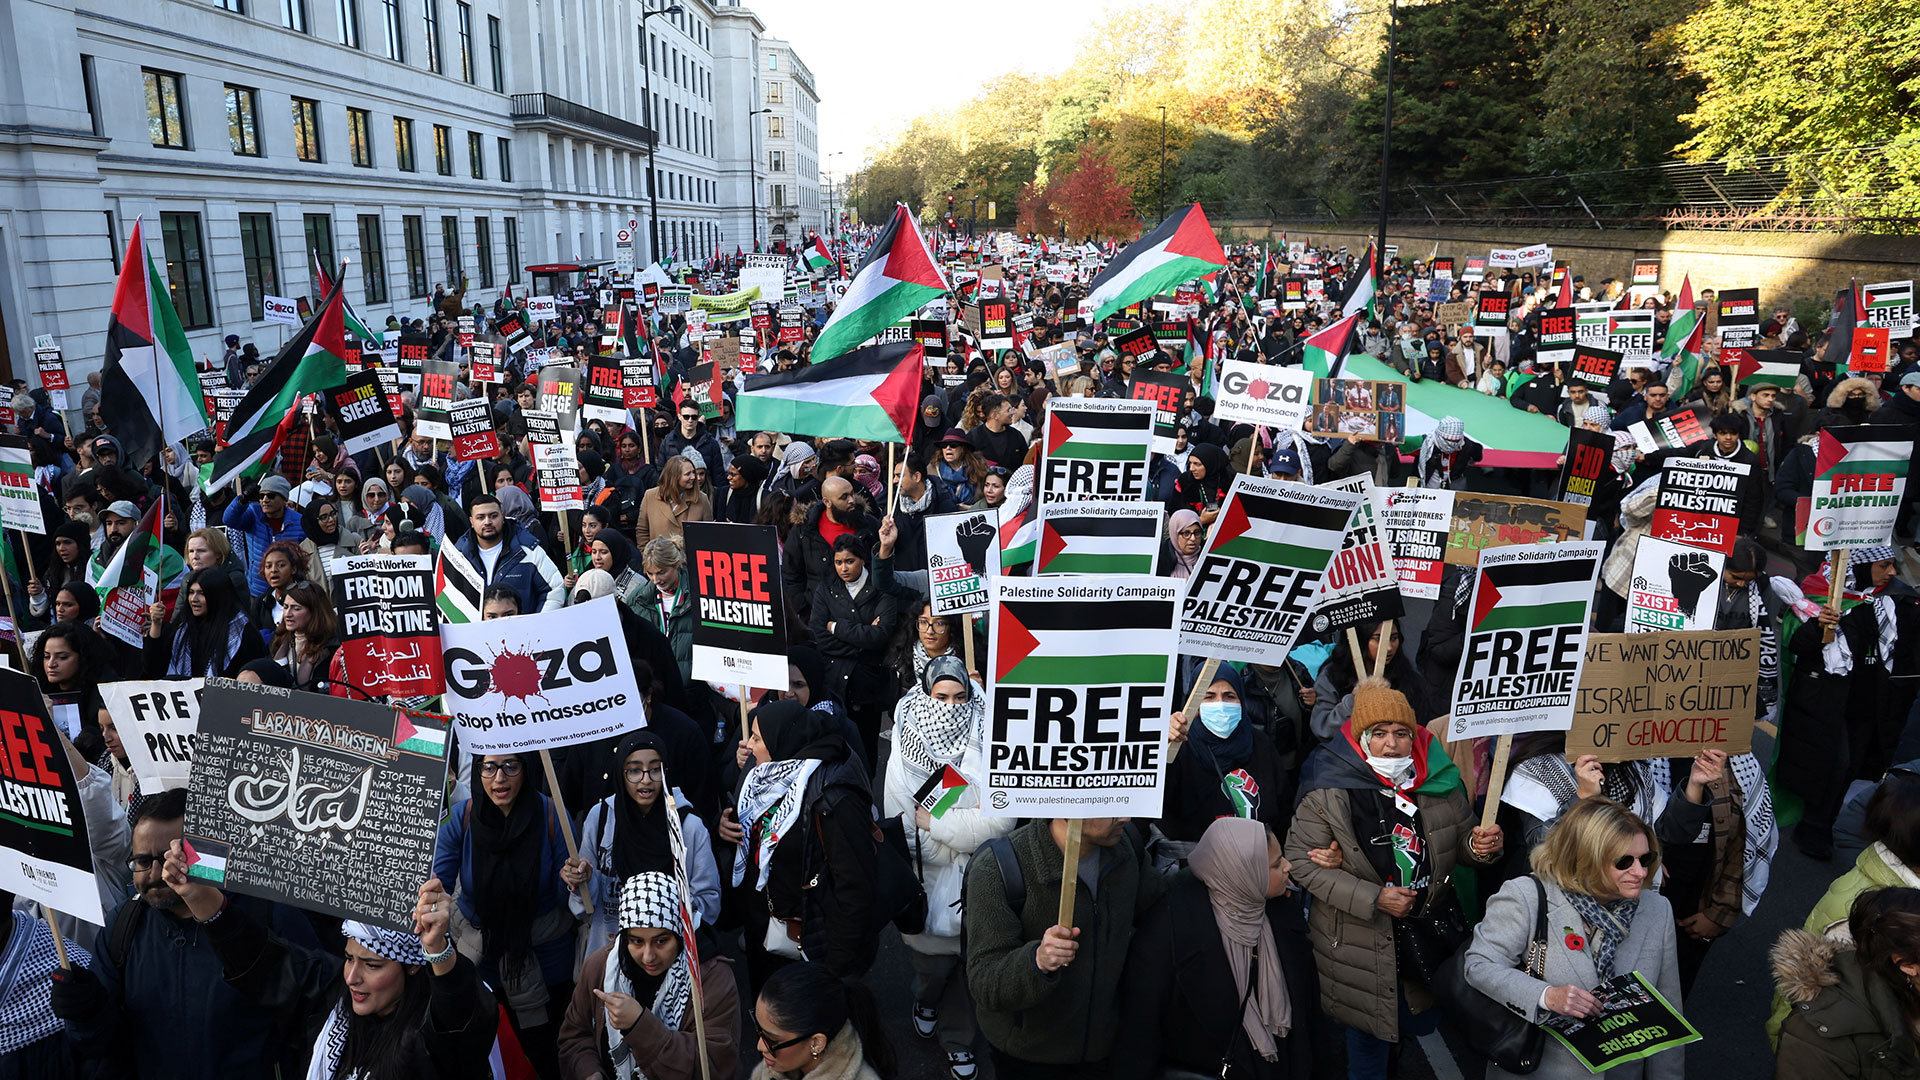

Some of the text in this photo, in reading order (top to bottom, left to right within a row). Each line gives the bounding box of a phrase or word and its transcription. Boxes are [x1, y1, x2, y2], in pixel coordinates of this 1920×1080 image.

[1435, 262, 1452, 270] FREE
[1634, 265, 1658, 275] FREE
[265, 300, 294, 313] Gza
[985, 304, 1006, 320] END
[1481, 298, 1508, 312] FREE
[1868, 306, 1910, 321] FREE
[985, 320, 1006, 328] ISRAELI
[1480, 312, 1506, 320] PALESTINE
[500, 319, 521, 335] FREE
[1542, 316, 1573, 334] FREE
[1122, 335, 1153, 356] FREE
[1541, 332, 1573, 342] PALESTINE
[1609, 335, 1650, 348] FREE
[1723, 340, 1753, 348] PALESTINE
[401, 345, 428, 359] FREE
[624, 366, 649, 375] FREEDOM
[1575, 355, 1616, 376] FREE
[423, 373, 454, 398] FREE
[623, 378, 652, 386] PALESTINE
[1572, 370, 1611, 385] PALESTINE
[335, 384, 376, 407] END THE
[543, 381, 573, 396] END THE
[1223, 372, 1303, 403] Gza
[541, 394, 571, 413] SIEGE
[1133, 381, 1181, 412] FREE
[340, 397, 382, 423] SIEGE
[451, 407, 486, 421] FREEDOM
[1051, 401, 1151, 413] Palestine Solidarity Campaign
[1220, 400, 1298, 418] Stop the massacre
[452, 420, 492, 436] PALESTINE
[527, 418, 555, 430] FREEDOM
[1572, 444, 1605, 480] END
[1045, 459, 1144, 494] FREE
[1668, 470, 1738, 491] FREEDOM
[1830, 473, 1896, 494] FREE
[1567, 476, 1596, 496] ISRAELI
[1237, 481, 1356, 509] Palestine Solidarity Campaign
[1398, 493, 1437, 501] Socialist
[1661, 492, 1737, 514] PALESTINE
[1816, 495, 1900, 509] PALESTINE
[1046, 507, 1158, 517] Palestine Solidarity Campaign
[1669, 514, 1719, 530] الحرية
[1396, 530, 1437, 545] ISRAELI
[1661, 529, 1723, 544] لفلسطين
[1400, 545, 1441, 559] TERROR
[1483, 548, 1598, 564] Palestine Solidarity Campaign
[933, 566, 972, 581] EXIST.
[1393, 560, 1432, 571] SOCIALIST
[696, 550, 770, 602] FREE
[344, 575, 424, 600] FREEDOM
[935, 579, 980, 596] RESIST.
[1000, 586, 1175, 599] Palestine Solidarity Campaign
[1188, 556, 1322, 614] FREE
[380, 600, 391, 610] for
[938, 592, 988, 610] RETURN.
[1330, 601, 1372, 616] PALESTINE
[1633, 593, 1677, 611] EXIST.
[700, 598, 773, 626] PALESTINE
[1183, 599, 1303, 634] PALESTINE
[1331, 605, 1378, 620] SOLIDARITY
[1332, 612, 1373, 626] CAMPAIGN
[1632, 608, 1683, 628] RESIST.
[346, 610, 433, 635] PALESTINE
[1195, 624, 1290, 645] ISRAELI OCCUPATION
[366, 641, 420, 661] الحرية
[1186, 637, 1265, 654] www.palestinecampaign.org
[1462, 626, 1583, 680] FREE
[1620, 643, 1658, 663] WANT
[1663, 638, 1752, 661] SANCTIONS
[443, 636, 617, 700] Gza
[724, 656, 735, 667] FOA
[205, 677, 292, 698] GLOBAL PEACE JOURNEY
[1459, 671, 1575, 702] PALESTINE
[1457, 695, 1568, 716] END ISRAELI OCCUPATION
[1577, 686, 1662, 714] ISRAEL
[1680, 684, 1751, 712] GUILTY
[457, 693, 627, 732] Stop the massacre
[992, 686, 1165, 744] FREE
[1471, 712, 1548, 727] www.palestinecampaign.org
[254, 710, 310, 739] LABAIK
[334, 725, 387, 756] HUSSEIN
[471, 742, 485, 750] Stop
[497, 740, 511, 749] War
[513, 738, 546, 748] Coalition
[549, 722, 625, 743] www.stopwar.org.uk
[1593, 718, 1730, 747] OF GENOCIDE
[0, 710, 62, 787] EE
[213, 735, 271, 753] WANT END
[990, 744, 1159, 771] PALESTINE
[379, 771, 426, 785] STOP THE
[991, 775, 1155, 787] END ISRAELI OCCUPATION
[396, 784, 441, 799] STOP THE
[1015, 795, 1129, 805] www.palestinecampaign.org
[0, 780, 72, 826] LESTINE
[923, 795, 937, 810] FOA
[355, 830, 383, 842] KILLING
[21, 862, 36, 880] FOA
[385, 857, 428, 874] GENOCIDE
[294, 887, 414, 929] BRINGS US TOGETHER TODAY
[1598, 1025, 1669, 1055] CEASEFIRE
